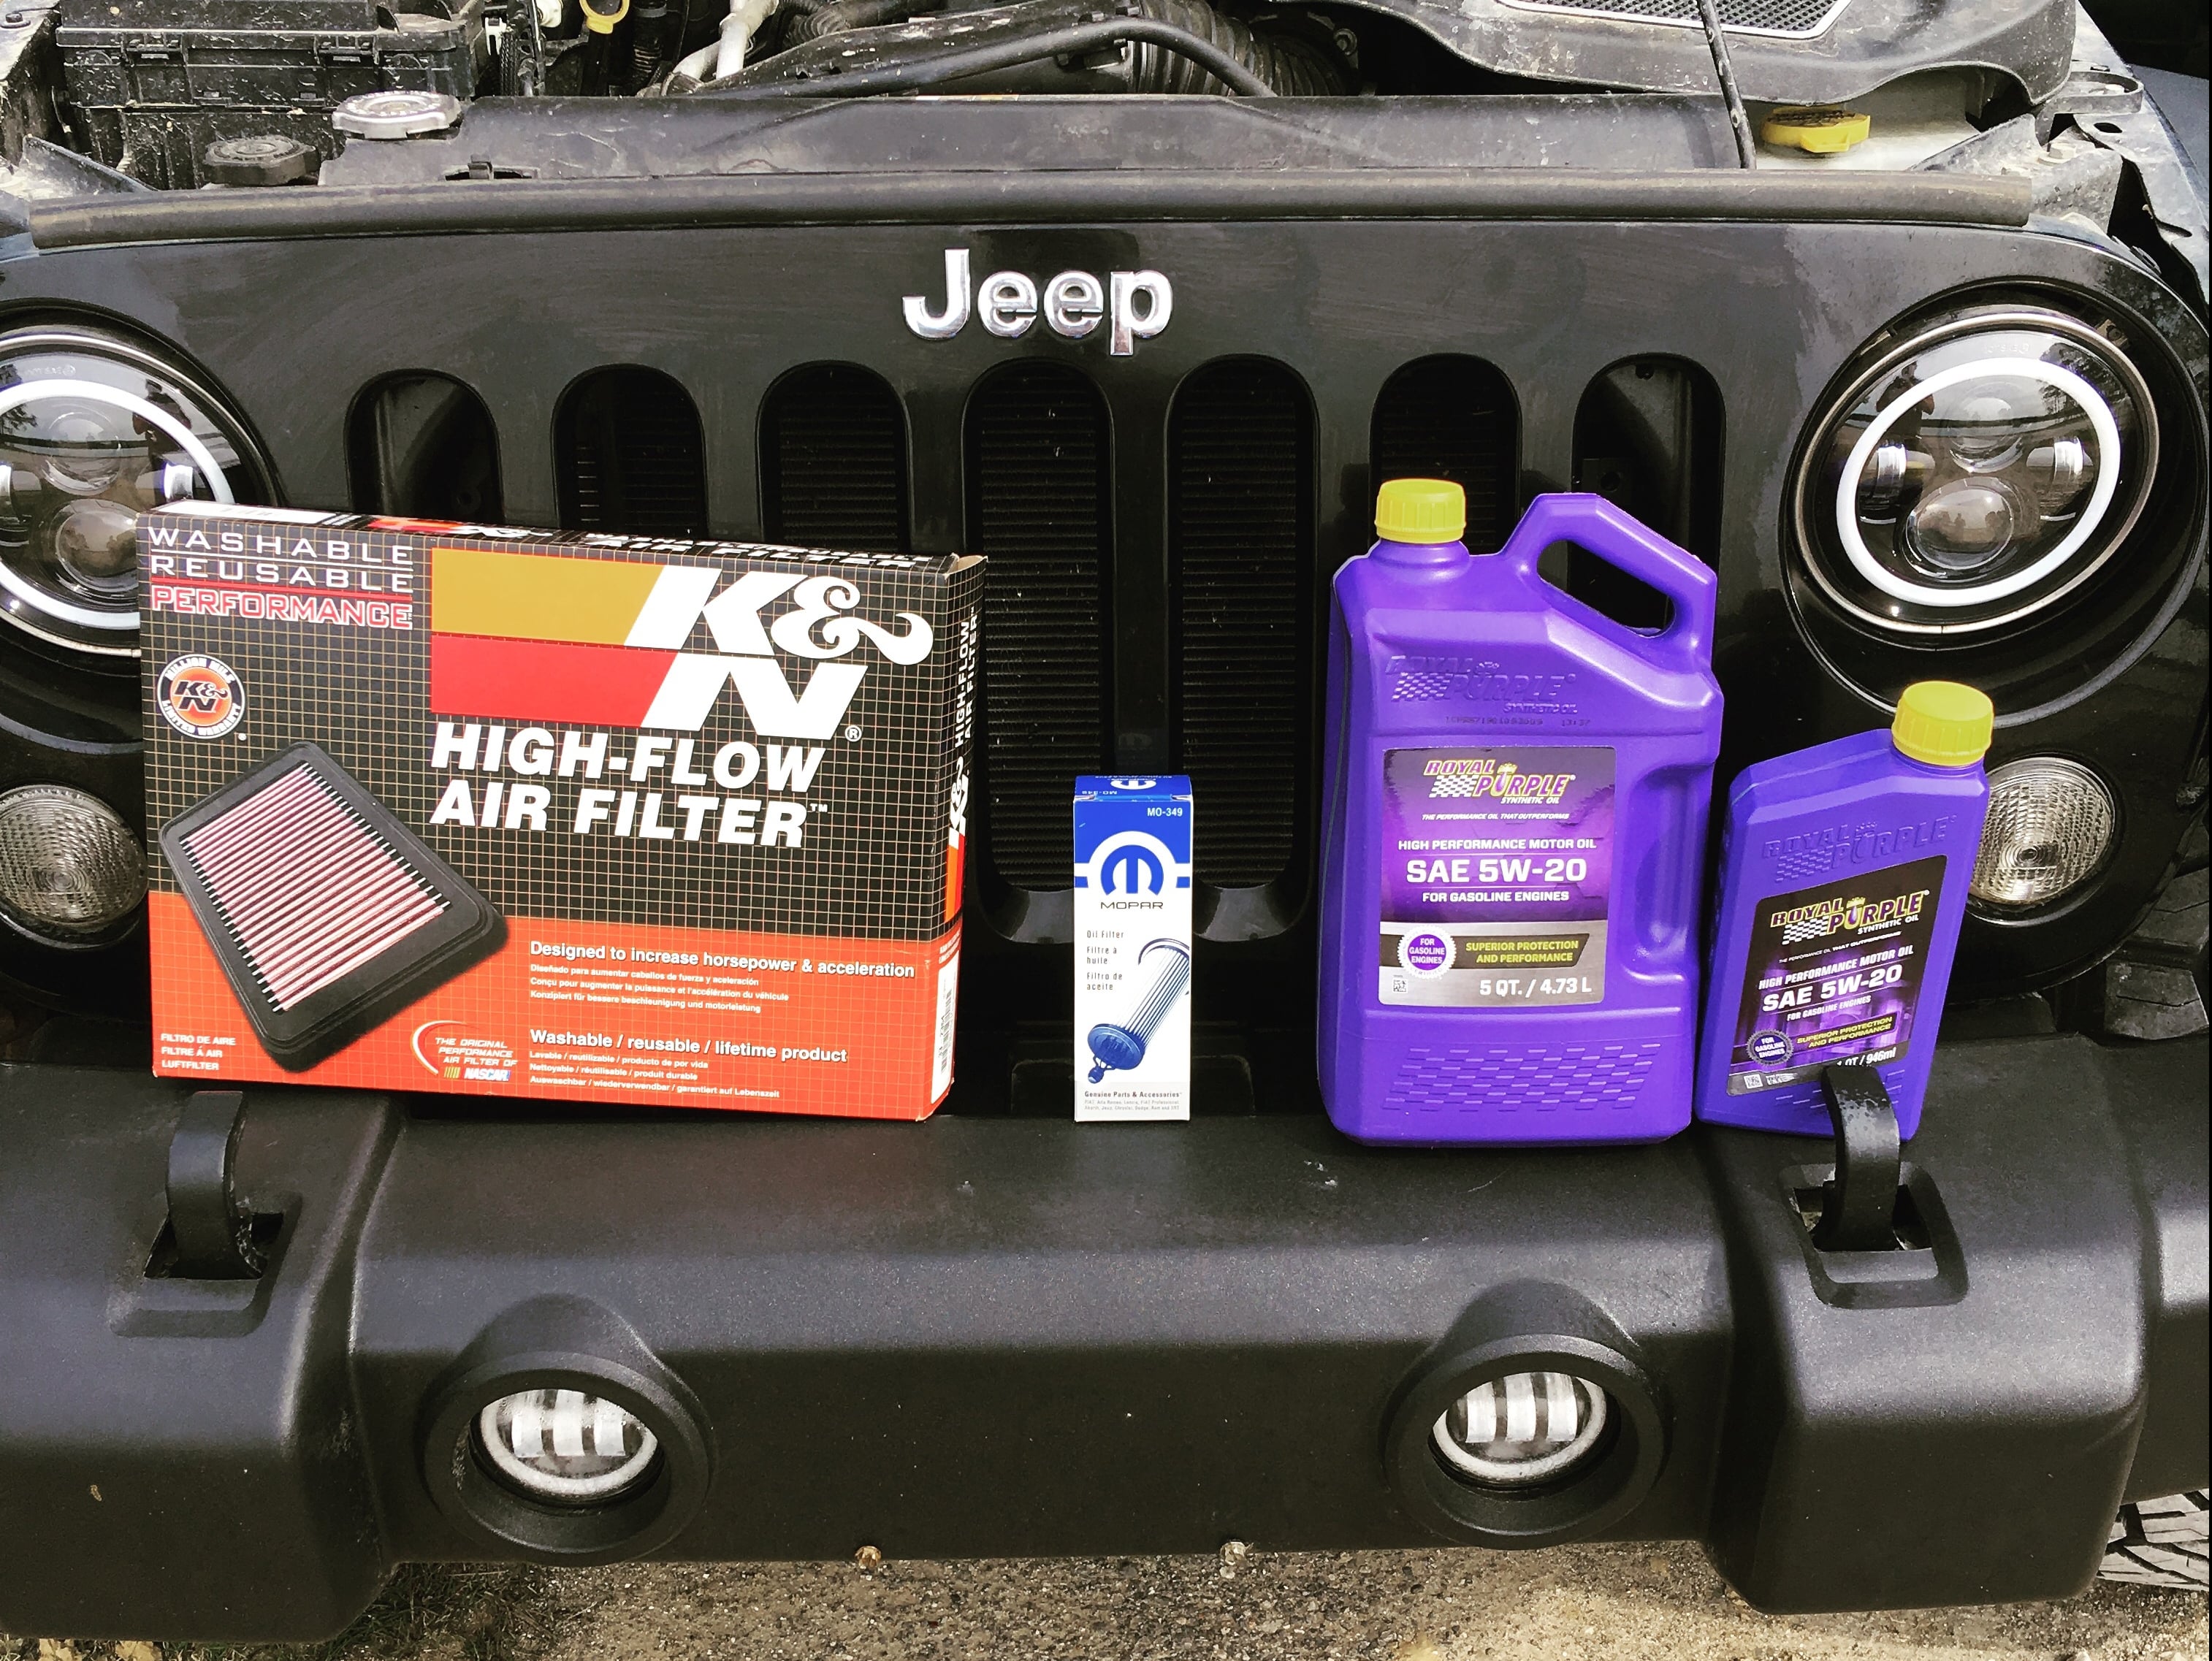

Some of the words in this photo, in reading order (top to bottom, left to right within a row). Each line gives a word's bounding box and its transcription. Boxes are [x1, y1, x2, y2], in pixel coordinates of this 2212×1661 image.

[902, 248, 1172, 356] Jeep
[148, 526, 413, 565] WASHABLE
[585, 541, 692, 551] AIR
[712, 549, 916, 568] FILTER
[151, 555, 413, 593] REUSABLE
[151, 584, 413, 630] PERFORMANCE
[955, 622, 971, 748] HIGH-FLOW
[1450, 673, 1565, 701] PURPLE
[964, 700, 974, 740] AIR
[430, 722, 826, 793] HIGH-FLOW
[1424, 759, 1495, 776] ROYAL
[1473, 771, 1570, 798] PURPLE
[430, 780, 552, 833] AIR
[1147, 808, 1183, 817] MO-349
[1398, 840, 1429, 850] HIGH
[1432, 840, 1525, 849] PERFORMANCE
[1529, 839, 1574, 849] MOTOR
[1577, 839, 1596, 849] OIL
[1763, 824, 1849, 858] ROYAL
[1832, 814, 1950, 869] PURPLE
[1406, 859, 1470, 883] SAE
[1479, 858, 1587, 882] 5W-20
[1422, 892, 1447, 902] FOR
[1451, 891, 1512, 902] GASOLINE
[1514, 891, 1569, 901] ENGINES
[1770, 897, 1844, 928] ROYAL
[1827, 890, 1924, 935] PURPLE
[1087, 931, 1098, 939] Oil
[1102, 931, 1124, 939] Filter
[1858, 919, 1902, 935] SYNTHETIC
[1904, 914, 1919, 923] OIL
[1409, 947, 1445, 955] GASOLINE
[1466, 942, 1515, 951] SUPERIOR
[1517, 940, 1579, 950] PROTECTION
[530, 941, 606, 961] Designed
[610, 947, 626, 961] to
[631, 947, 698, 965] increase
[703, 952, 796, 971] horsepower
[801, 958, 813, 973] &
[817, 961, 915, 977] acceleration
[1411, 956, 1442, 964] ENGINES
[1476, 954, 1498, 963] AND
[1500, 952, 1573, 963] PERFORMANCE
[1758, 976, 1782, 990] HIGH
[1785, 958, 1857, 985] PERFORMANCE
[1859, 951, 1895, 967] MOTOR
[1898, 945, 1914, 958] OIL
[530, 964, 568, 974] Diseñado
[571, 967, 589, 977] para
[591, 969, 628, 977] aumentar
[631, 971, 665, 980] caballos
[667, 972, 676, 980] de
[679, 974, 703, 982] fuerza
[713, 976, 758, 985] aceleración
[530, 977, 557, 988] Conçu
[559, 980, 577, 989] pour
[580, 982, 622, 990] augmenter
[635, 985, 675, 994] puissance
[678, 986, 685, 994] et
[687, 987, 740, 998] l'accélération
[743, 990, 752, 998] du
[755, 991, 789, 1001] véhicule
[1479, 980, 1491, 995] 5
[1495, 980, 1522, 996] QT.
[1525, 979, 1537, 998] /
[1540, 978, 1577, 994] 4.73
[1582, 977, 1592, 992] L
[1762, 985, 1813, 1012] SAE
[1820, 964, 1903, 999] 5W-20
[530, 990, 572, 1001] Konzipiert
[573, 992, 585, 1001] für
[587, 994, 619, 1003] bessere
[621, 996, 685, 1009] beschleunigung
[687, 1000, 703, 1008] und
[705, 1001, 760, 1013] motorleistung
[1787, 1012, 1801, 1021] FOR
[1802, 1003, 1837, 1018] GASOLINE
[1839, 996, 1871, 1009] ENGINES
[161, 1033, 194, 1043] FILTRO
[197, 1036, 210, 1044] DE
[213, 1036, 236, 1045] AIRE
[1796, 1030, 1838, 1044] SUPERIOR
[1839, 1016, 1893, 1034] PROTECTION
[1809, 1039, 1827, 1048] AND
[1828, 1023, 1891, 1043] PERFORMANCE
[161, 1047, 194, 1056] FILTRE
[206, 1050, 223, 1058] AIR
[435, 1037, 456, 1045] THE
[459, 1039, 508, 1048] ORIGINAL
[438, 1047, 514, 1058] PERFORMANCE
[530, 1028, 613, 1047] Washable
[628, 1037, 701, 1053] reusable
[715, 1041, 777, 1058] lifetime
[782, 1047, 847, 1062] product
[1755, 1042, 1785, 1052] GASOLINE
[161, 1060, 219, 1070] LUFTFILTER
[464, 1058, 499, 1066] FILTER
[530, 1050, 562, 1059] Lavable
[569, 1053, 615, 1063] reutilizable
[622, 1057, 659, 1066] producto
[674, 1061, 688, 1069] por
[690, 1061, 709, 1069] vida
[1866, 1047, 1896, 1064] 946ml
[464, 1067, 510, 1081] NASCAR
[530, 1064, 574, 1073] Nettoyable
[634, 1069, 664, 1079] produit
[666, 1071, 698, 1080] durable
[530, 1076, 587, 1086] Auswaschbar
[677, 1085, 717, 1094] garantiert
[735, 1088, 779, 1098] Lebenszeit
